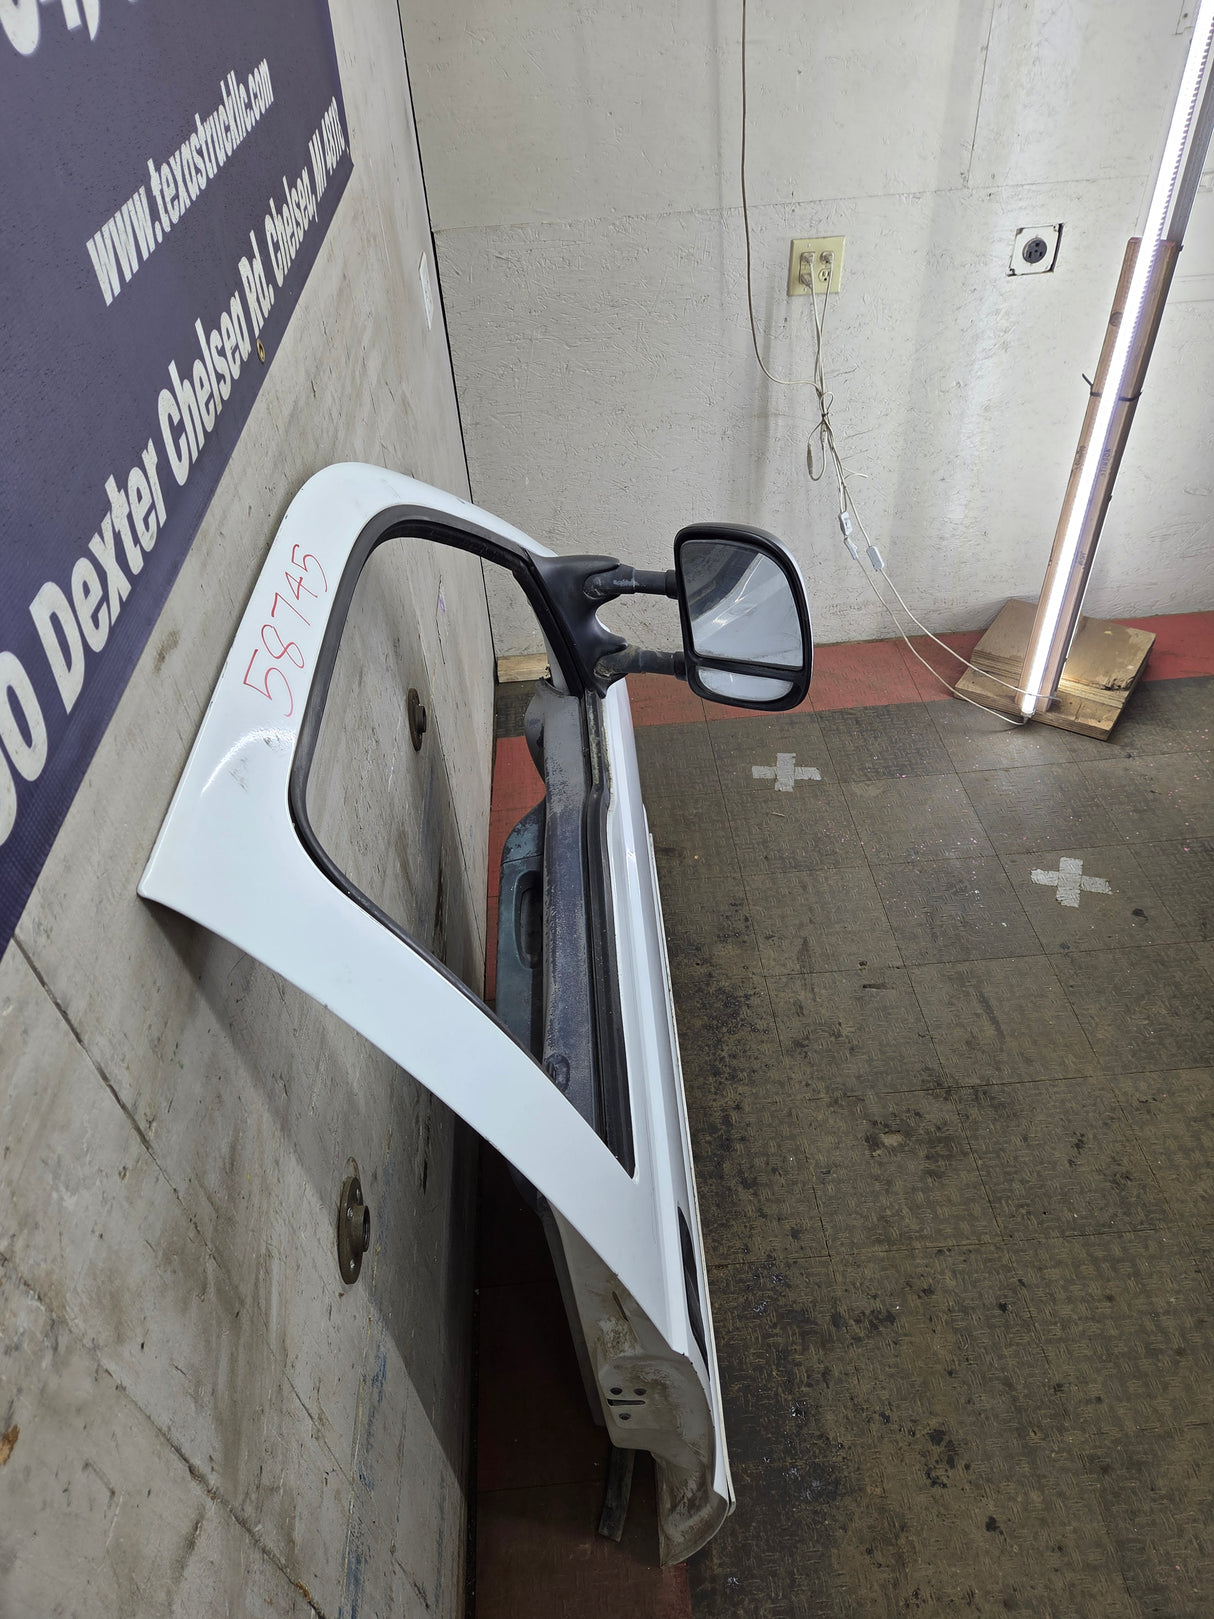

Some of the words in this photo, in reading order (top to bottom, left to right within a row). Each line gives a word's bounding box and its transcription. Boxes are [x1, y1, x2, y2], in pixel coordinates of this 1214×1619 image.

[86, 58, 274, 307] www.texastruckllc.com
[0, 650, 48, 846] 0
[29, 437, 167, 714] Dexter
[158, 290, 252, 486] Chelsea
[238, 229, 275, 339] Rd.
[265, 165, 318, 287] Chelsea,
[308, 128, 327, 203] MI
[243, 543, 328, 717] 58745
